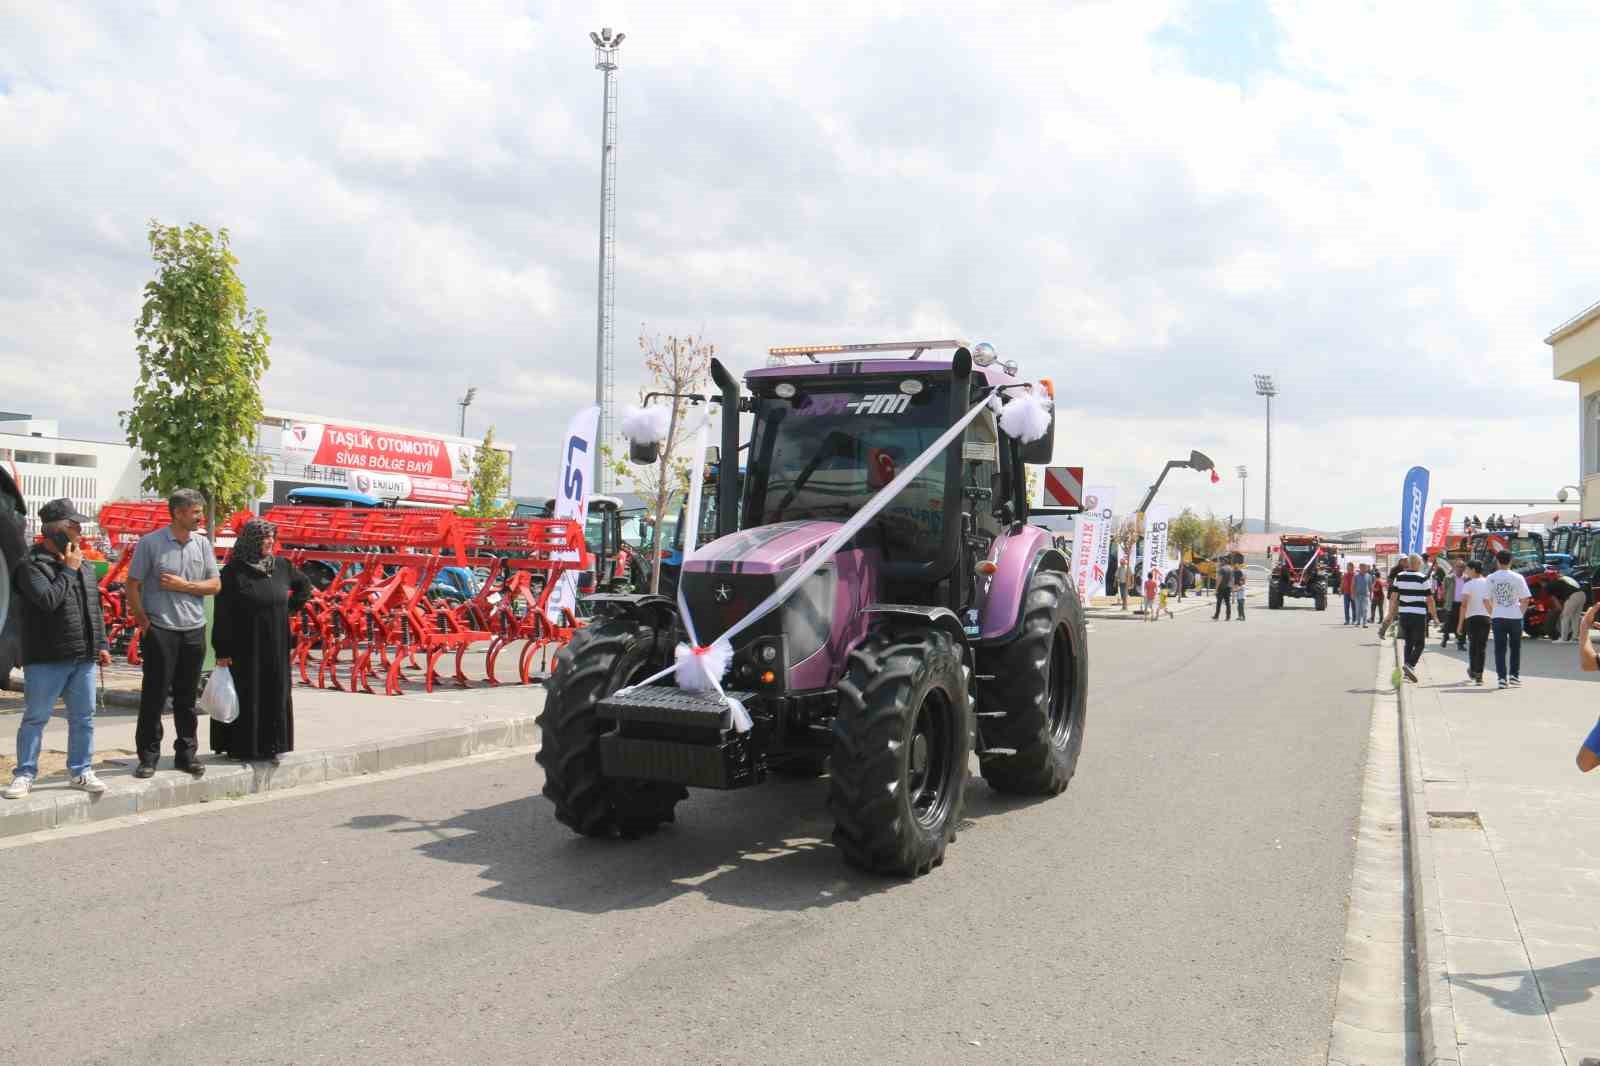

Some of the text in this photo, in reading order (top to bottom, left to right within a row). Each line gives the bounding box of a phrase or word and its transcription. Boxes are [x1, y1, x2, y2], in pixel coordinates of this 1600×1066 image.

[327, 429, 440, 457] TAŞLİK OTOMOTİV
[336, 450, 367, 466] SİVAS
[368, 455, 405, 471] BÖLGE
[564, 435, 588, 501] LS
